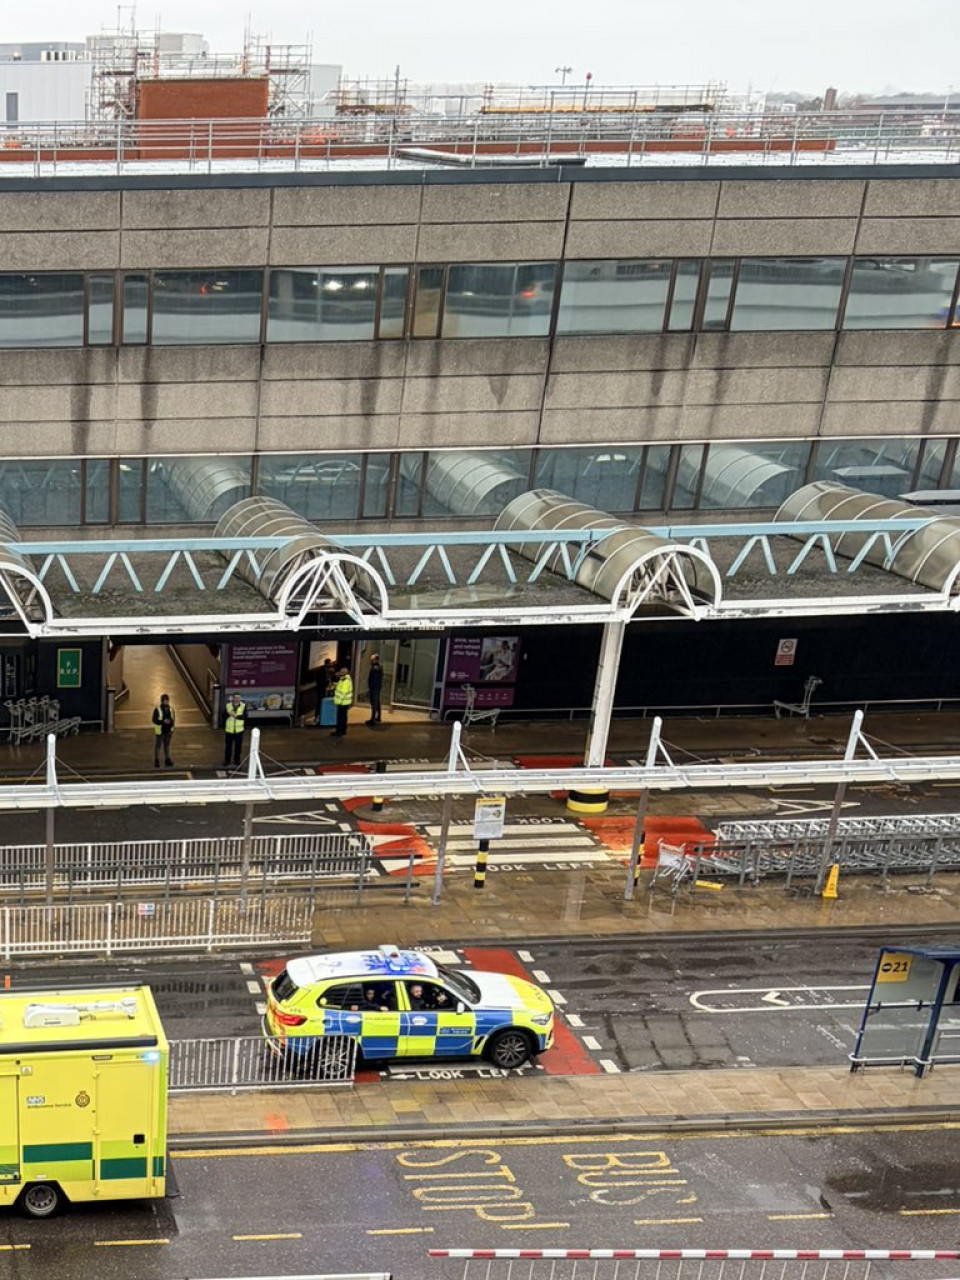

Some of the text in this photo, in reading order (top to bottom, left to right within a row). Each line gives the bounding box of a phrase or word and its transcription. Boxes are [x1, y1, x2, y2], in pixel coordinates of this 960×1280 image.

[543, 862, 595, 871] LEFT
[892, 961, 908, 972] 21
[416, 1069, 464, 1080] LOOK
[563, 1150, 699, 1206] BUS
[396, 1149, 536, 1221] STOP
